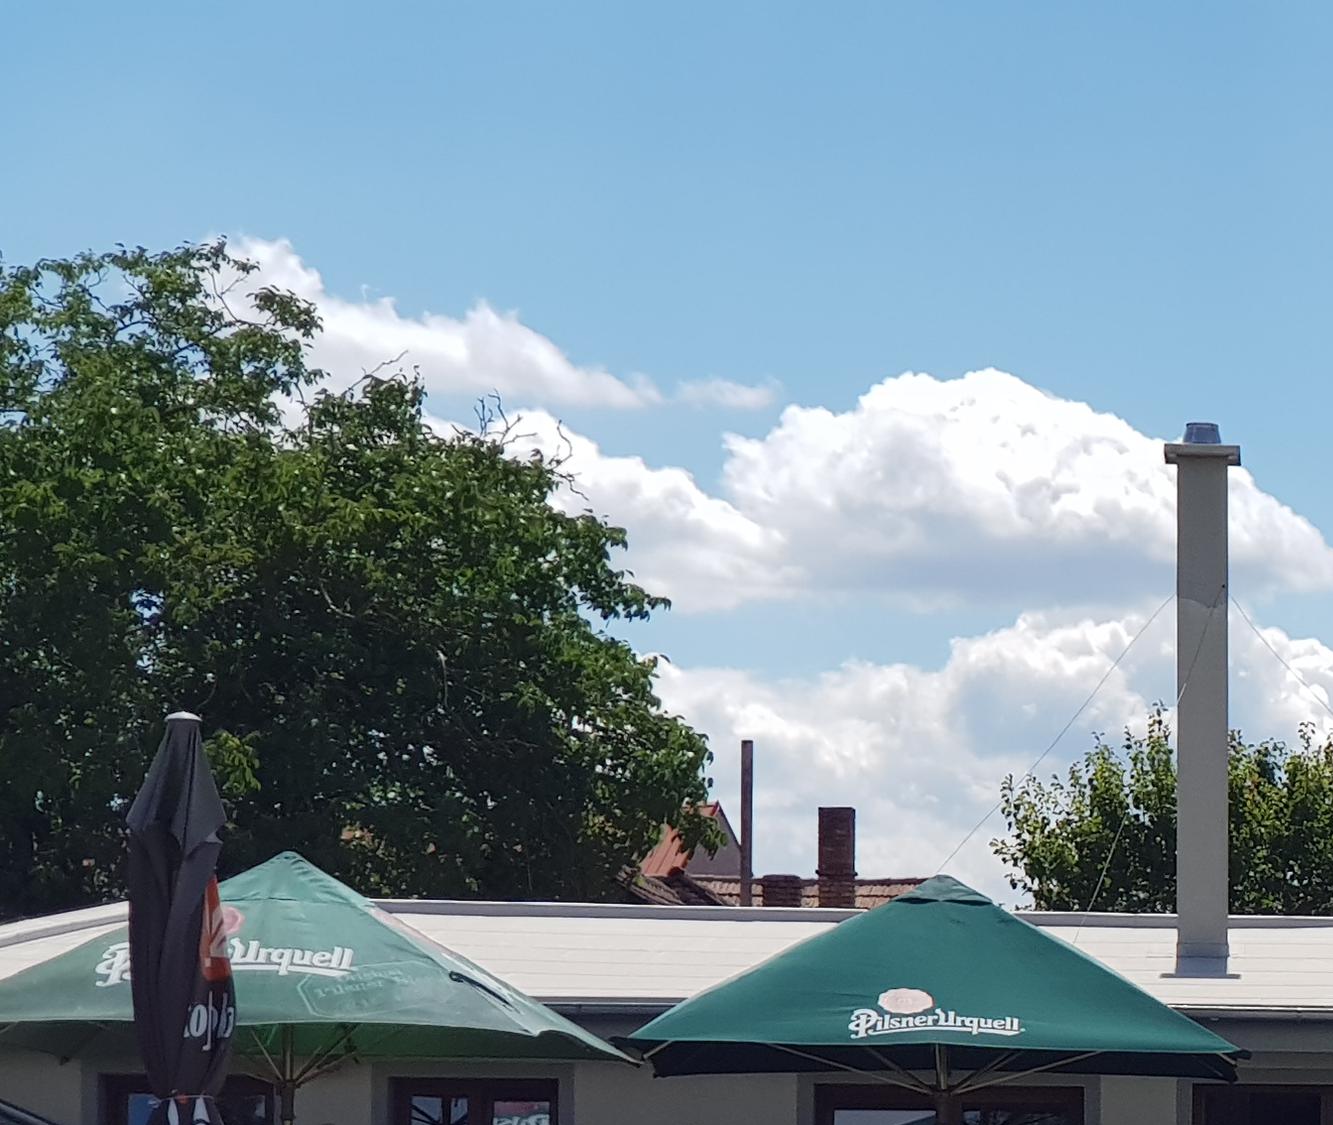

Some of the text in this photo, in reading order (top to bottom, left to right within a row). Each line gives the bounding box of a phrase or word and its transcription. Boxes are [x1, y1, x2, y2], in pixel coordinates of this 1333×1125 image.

[228, 937, 357, 976] Urquell
[848, 1008, 1022, 1040] Pilsner Urquell
